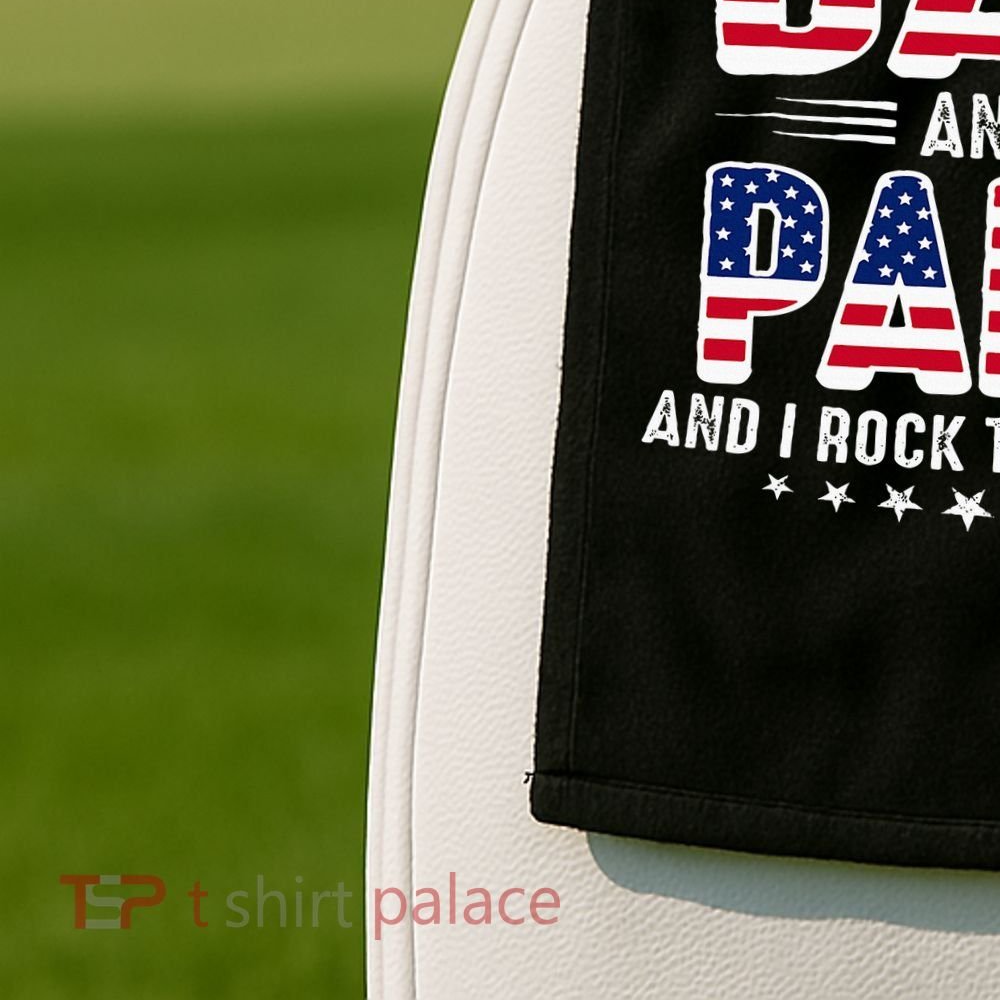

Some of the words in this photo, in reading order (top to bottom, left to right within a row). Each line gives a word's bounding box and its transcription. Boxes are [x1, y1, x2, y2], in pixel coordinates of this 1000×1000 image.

[641, 389, 760, 455] AND
[779, 402, 797, 459] I
[816, 405, 967, 472] ROCK
